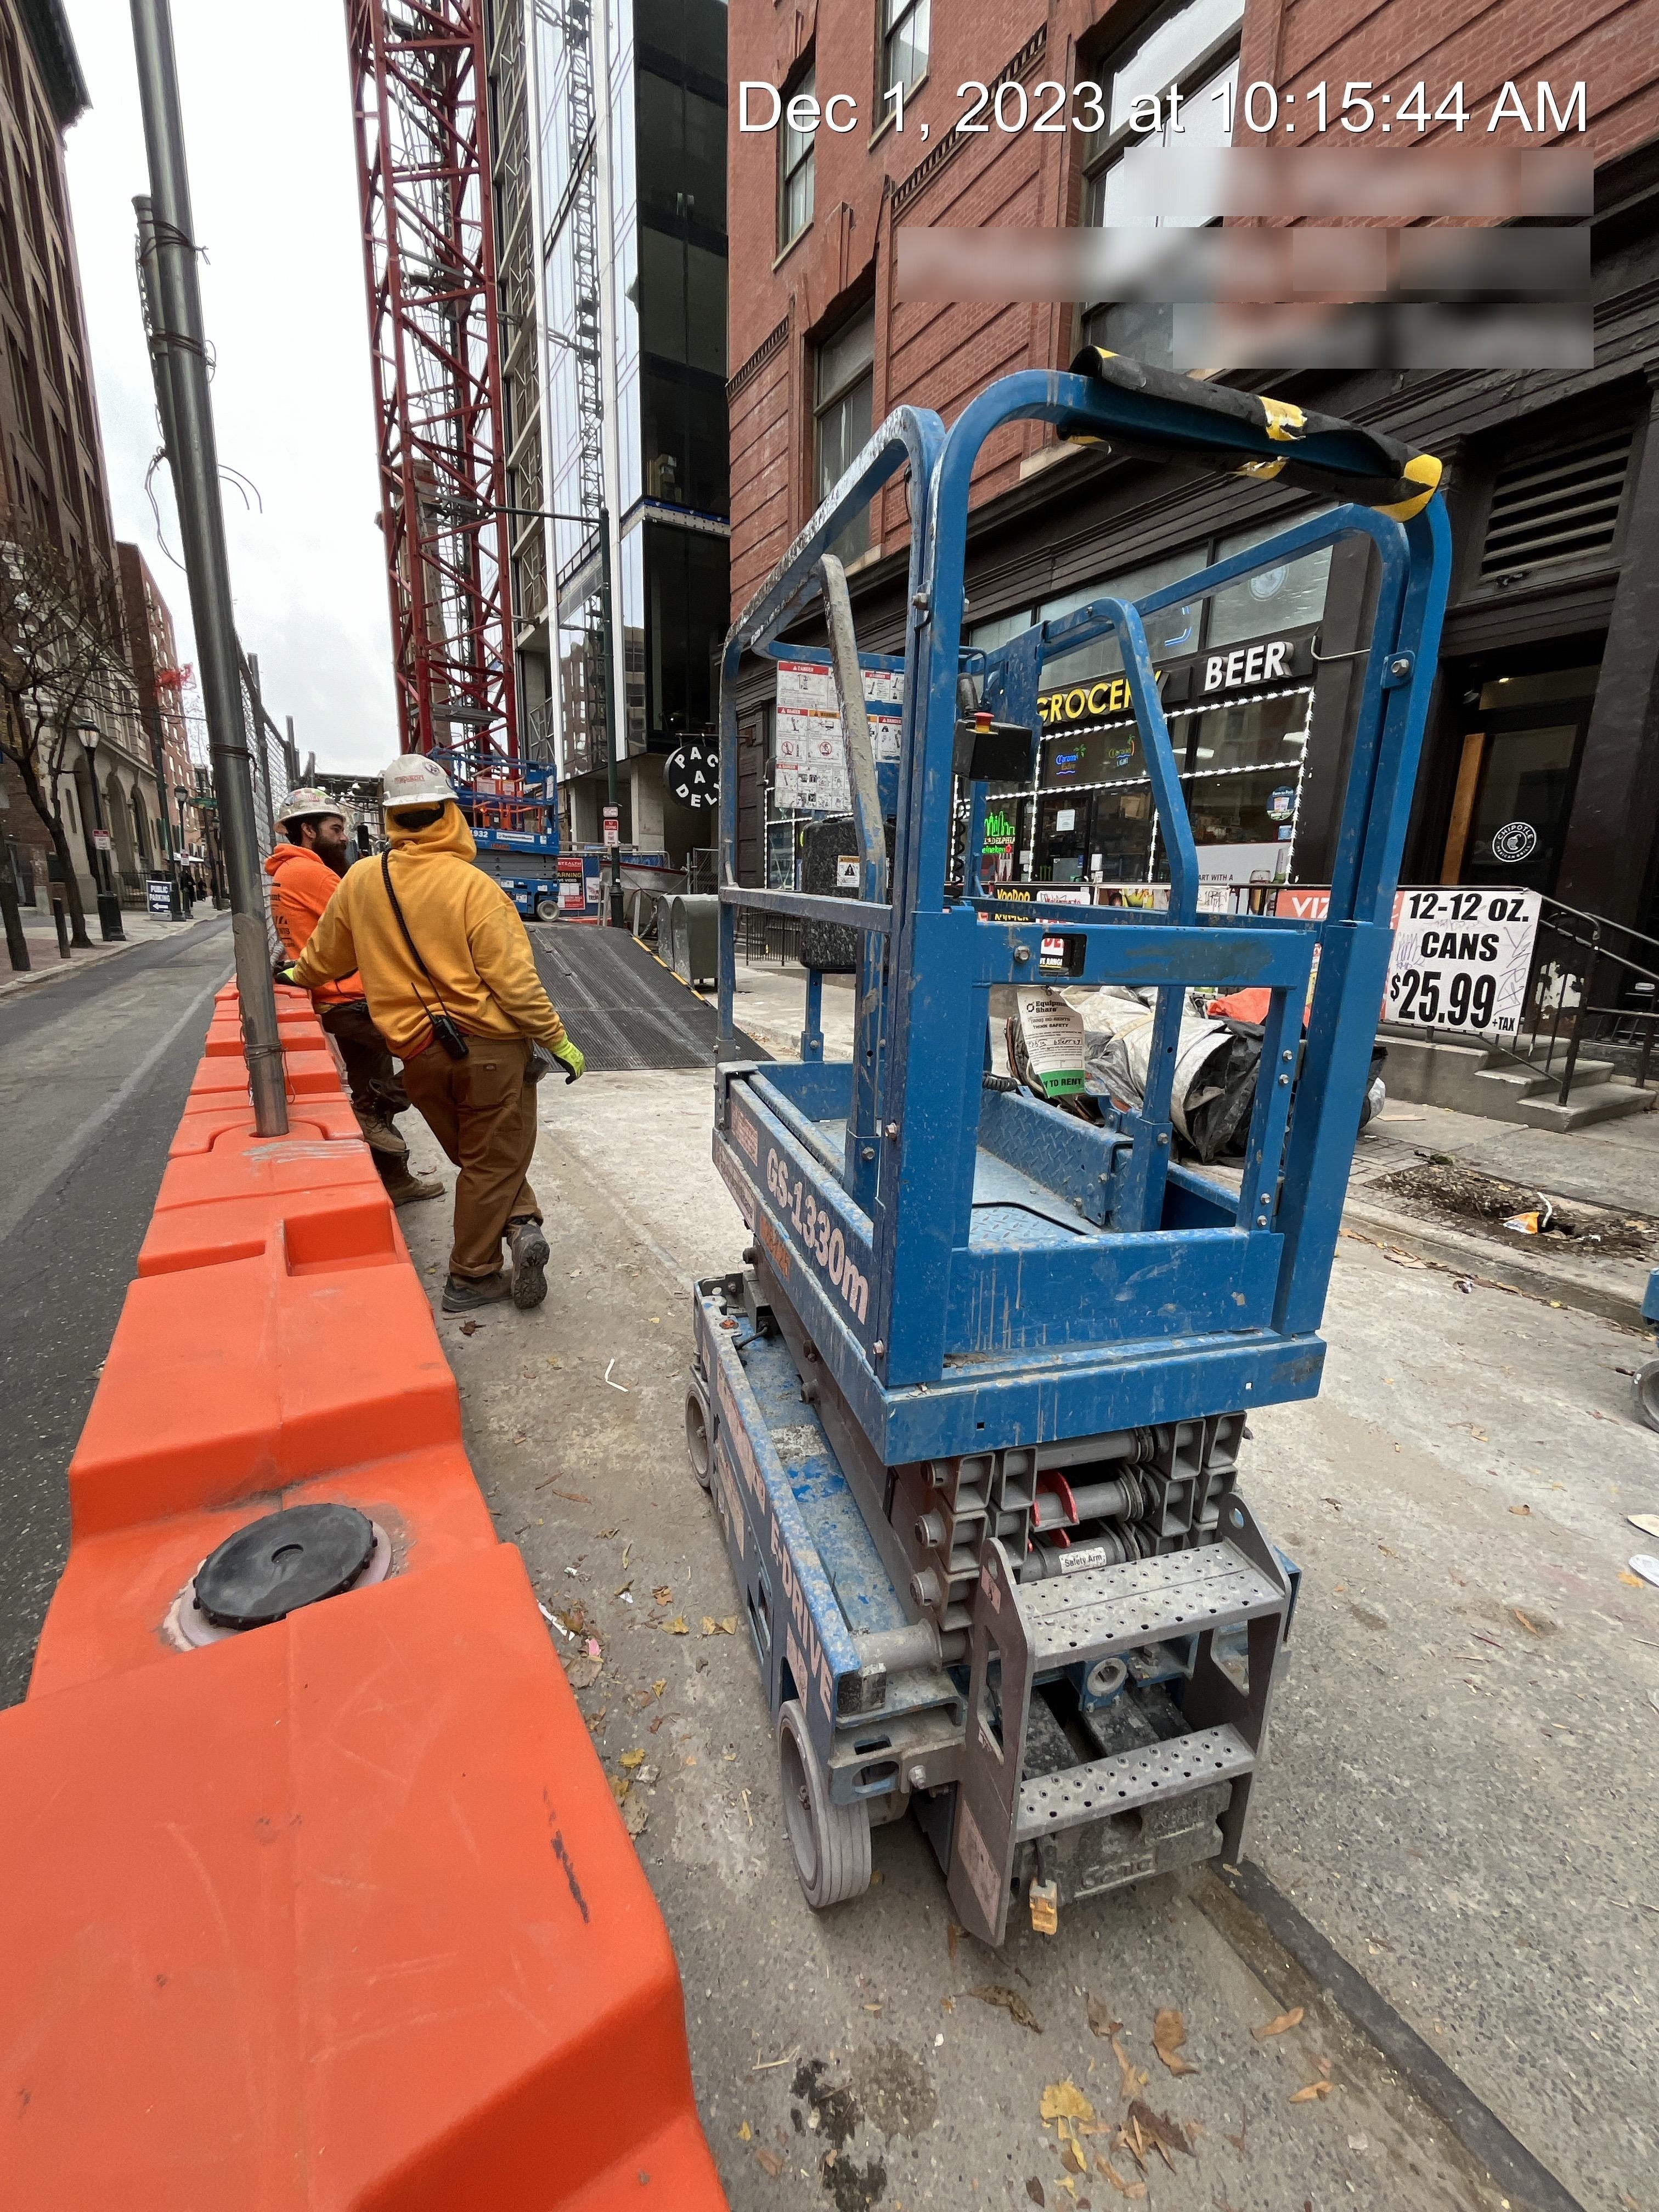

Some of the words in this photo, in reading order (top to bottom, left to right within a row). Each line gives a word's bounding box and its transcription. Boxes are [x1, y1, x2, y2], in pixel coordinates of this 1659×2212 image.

[1204, 641, 1287, 691] BEER
[1037, 670, 1161, 723] GROCE
[1056, 754, 1078, 765] Corona
[1497, 825, 1533, 840] CHIPOTLE
[982, 845, 1006, 854] eineken
[1409, 893, 1482, 921] 12-12
[1488, 898, 1529, 922] OZ.
[1420, 932, 1499, 961] CANS
[1390, 969, 1497, 1029] $25.99
[1061, 1078, 1082, 1086] RENT
[767, 1148, 868, 1325] GS-1330m
[1064, 1555, 1086, 1567] Safety
[1088, 1554, 1103, 1563] Arm
[771, 1512, 833, 1723] E-DRIVE
